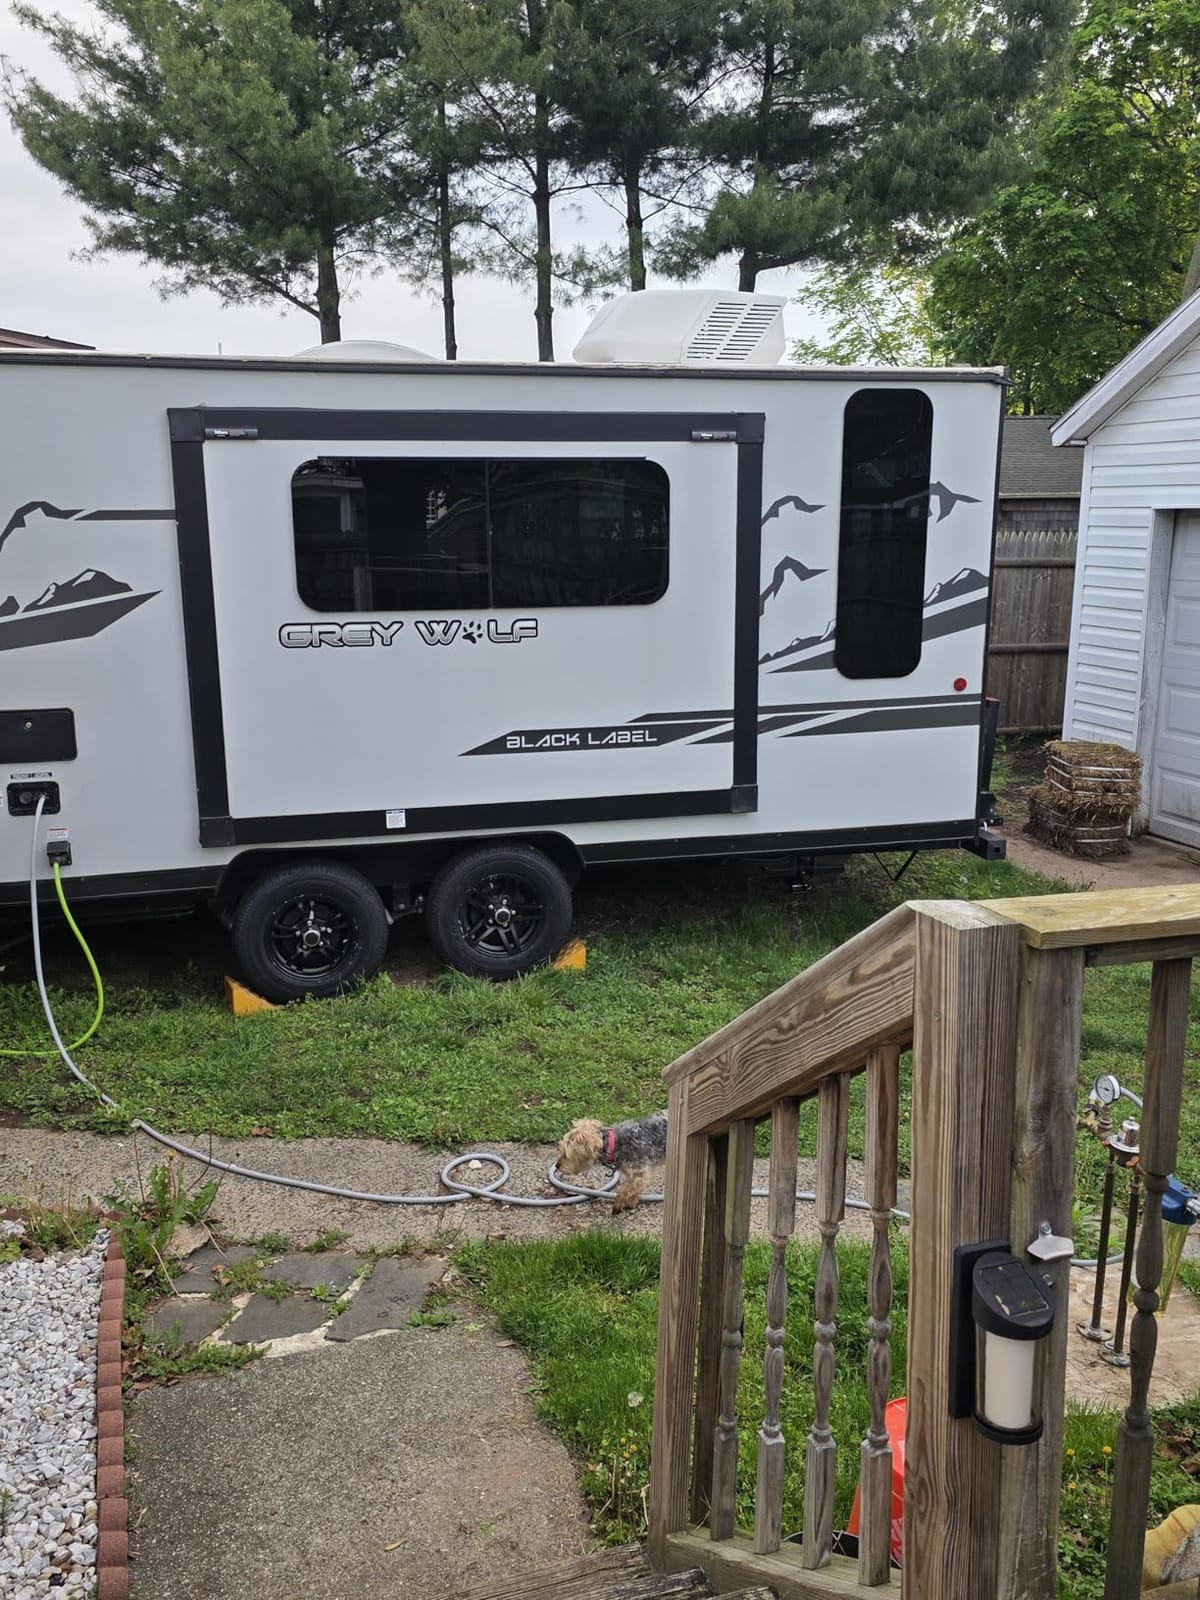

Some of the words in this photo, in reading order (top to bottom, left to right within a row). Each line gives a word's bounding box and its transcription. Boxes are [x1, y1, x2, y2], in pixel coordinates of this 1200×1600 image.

[279, 621, 404, 648] GREY
[506, 735, 580, 749] BLACK
[587, 730, 658, 745] LABEL
